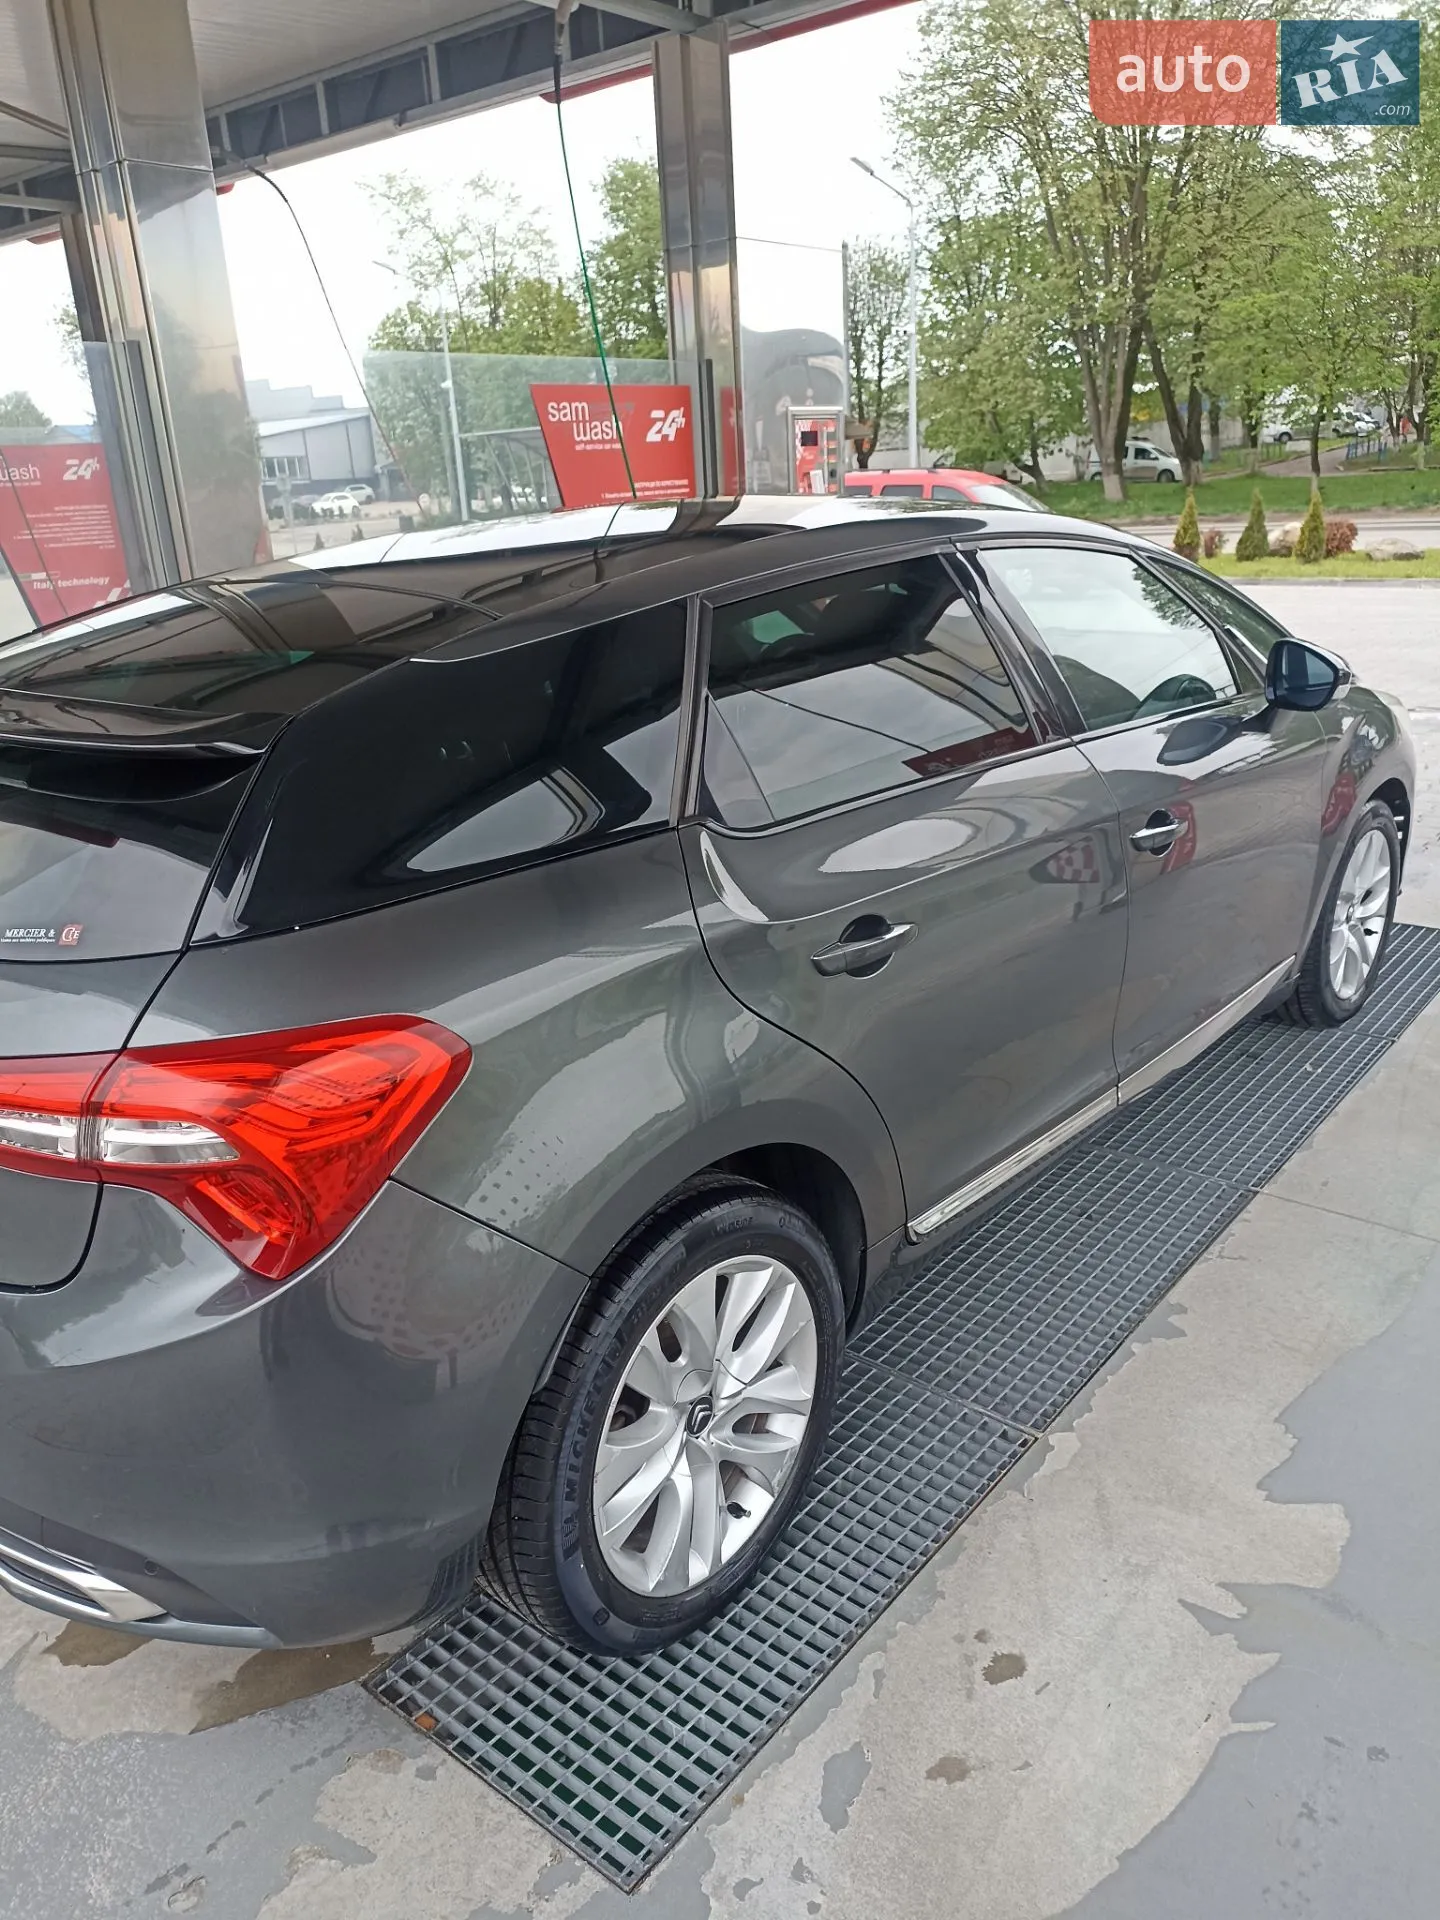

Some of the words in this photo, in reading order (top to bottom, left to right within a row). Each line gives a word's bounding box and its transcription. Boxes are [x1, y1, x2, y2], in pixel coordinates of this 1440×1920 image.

[547, 401, 590, 422] sam
[573, 414, 623, 441] wash
[57, 576, 110, 588] technology
[4, 928, 47, 938] MERCIER
[48, 928, 56, 938] &
